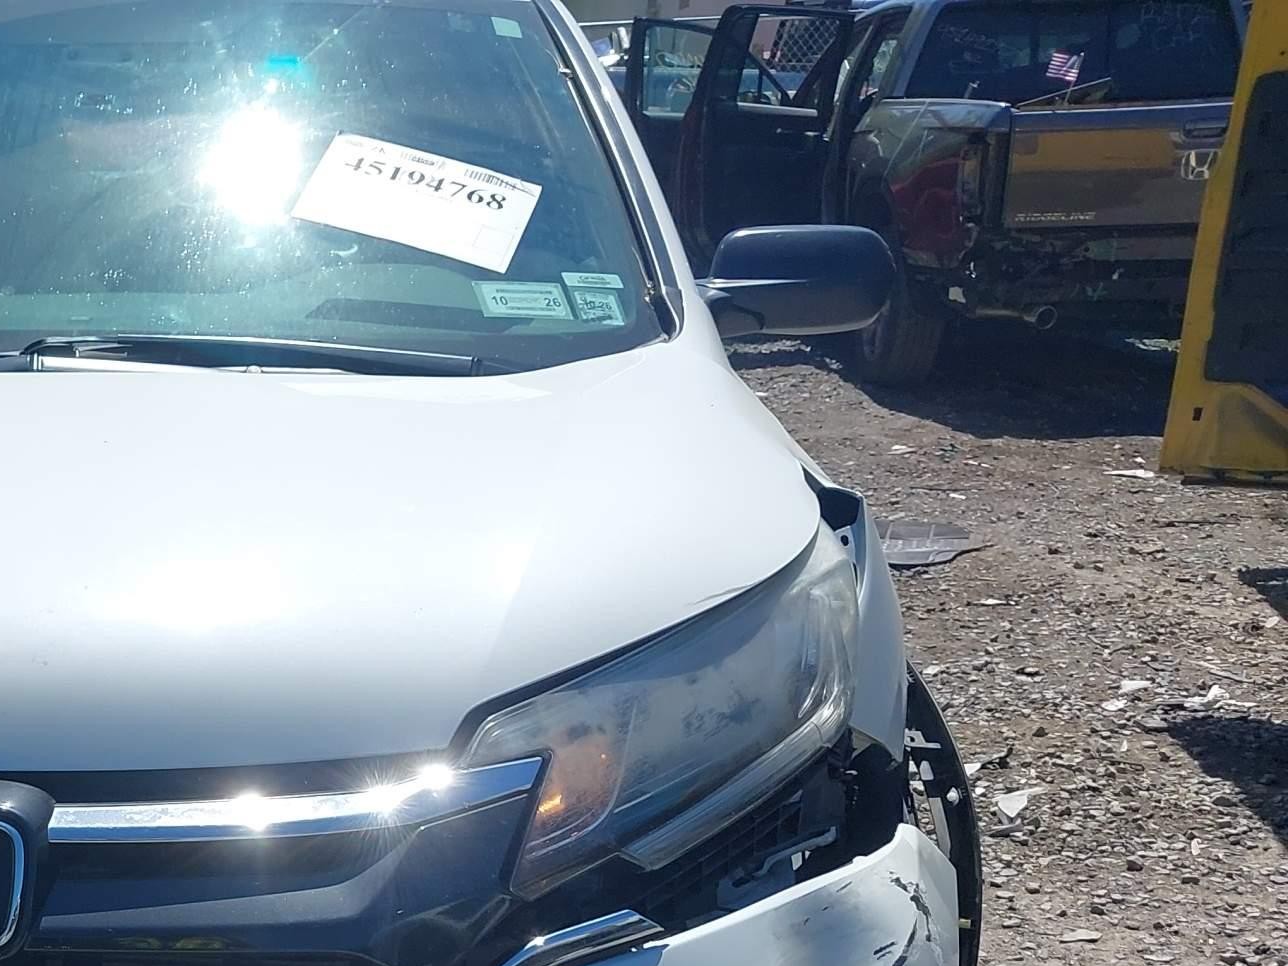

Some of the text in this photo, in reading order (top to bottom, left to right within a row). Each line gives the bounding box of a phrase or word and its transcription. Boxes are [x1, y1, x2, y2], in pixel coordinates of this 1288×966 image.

[344, 157, 508, 211] 45194768
[1014, 211, 1097, 222] RIDGELINE
[491, 295, 509, 306] 10
[543, 297, 562, 308] 26
